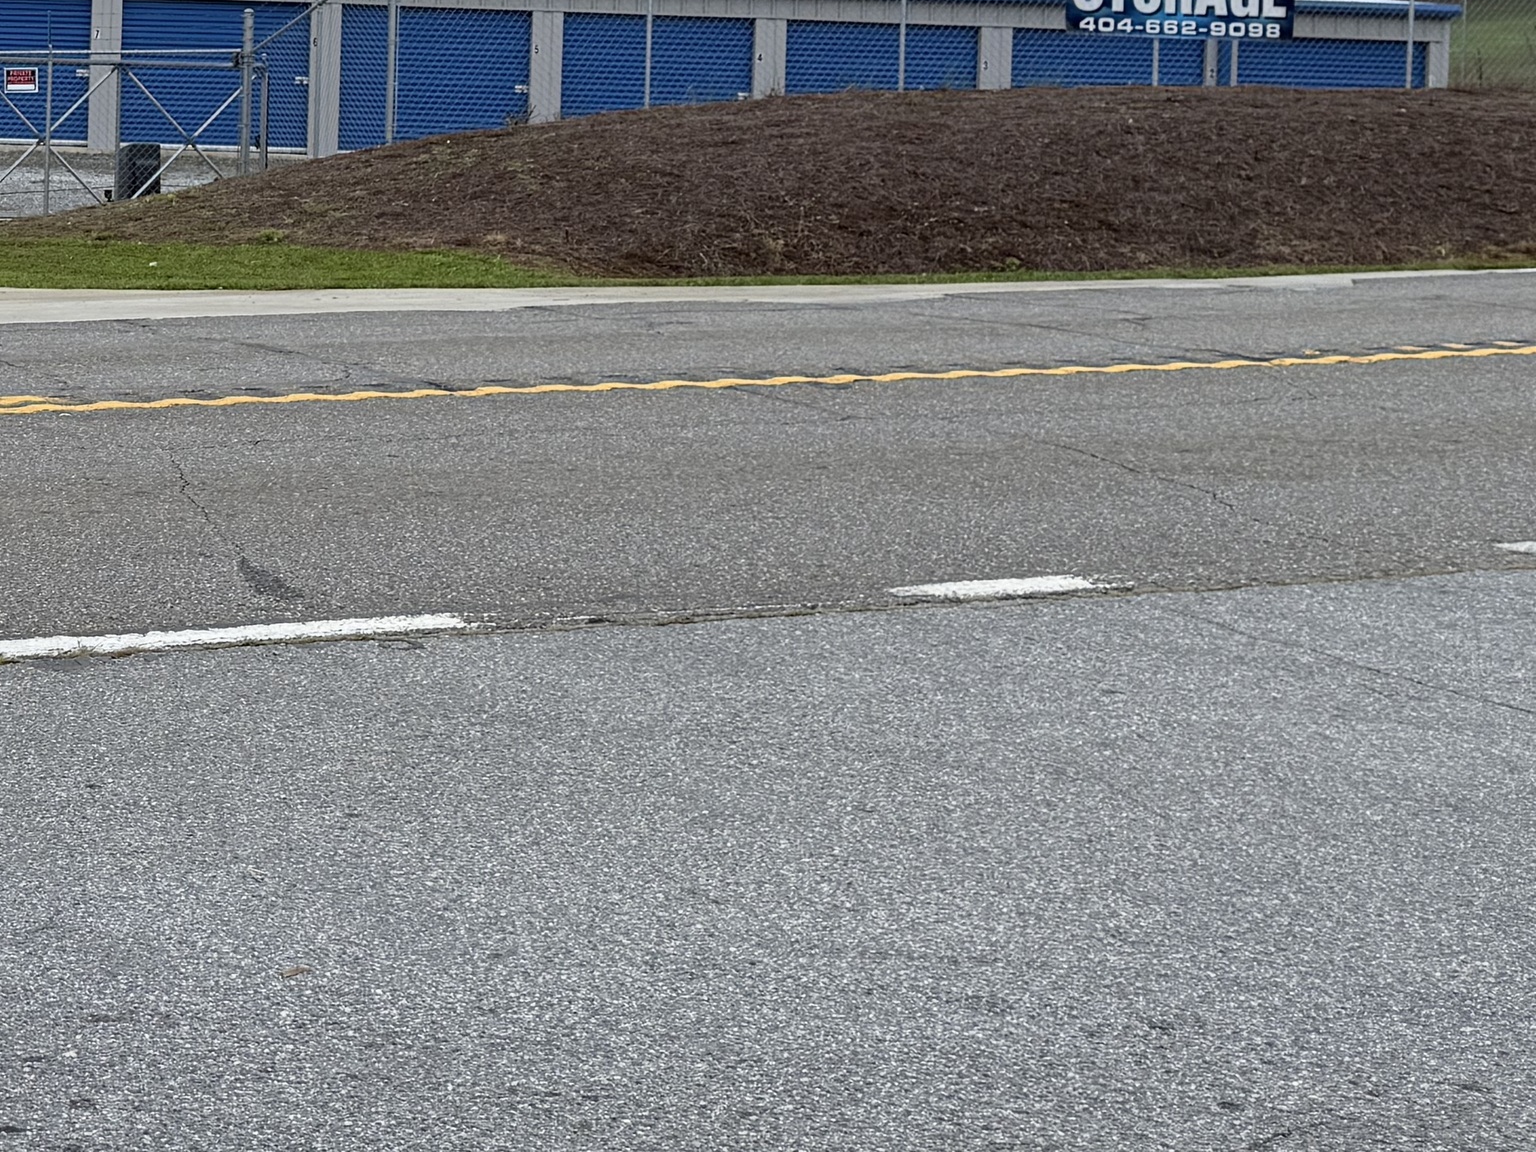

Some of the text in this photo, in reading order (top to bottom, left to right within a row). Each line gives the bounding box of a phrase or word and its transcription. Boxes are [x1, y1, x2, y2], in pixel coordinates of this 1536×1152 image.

[1079, 16, 1282, 39] 404-662-9098
[94, 29, 100, 39] 7
[534, 45, 540, 54] 5
[756, 53, 763, 62] 4
